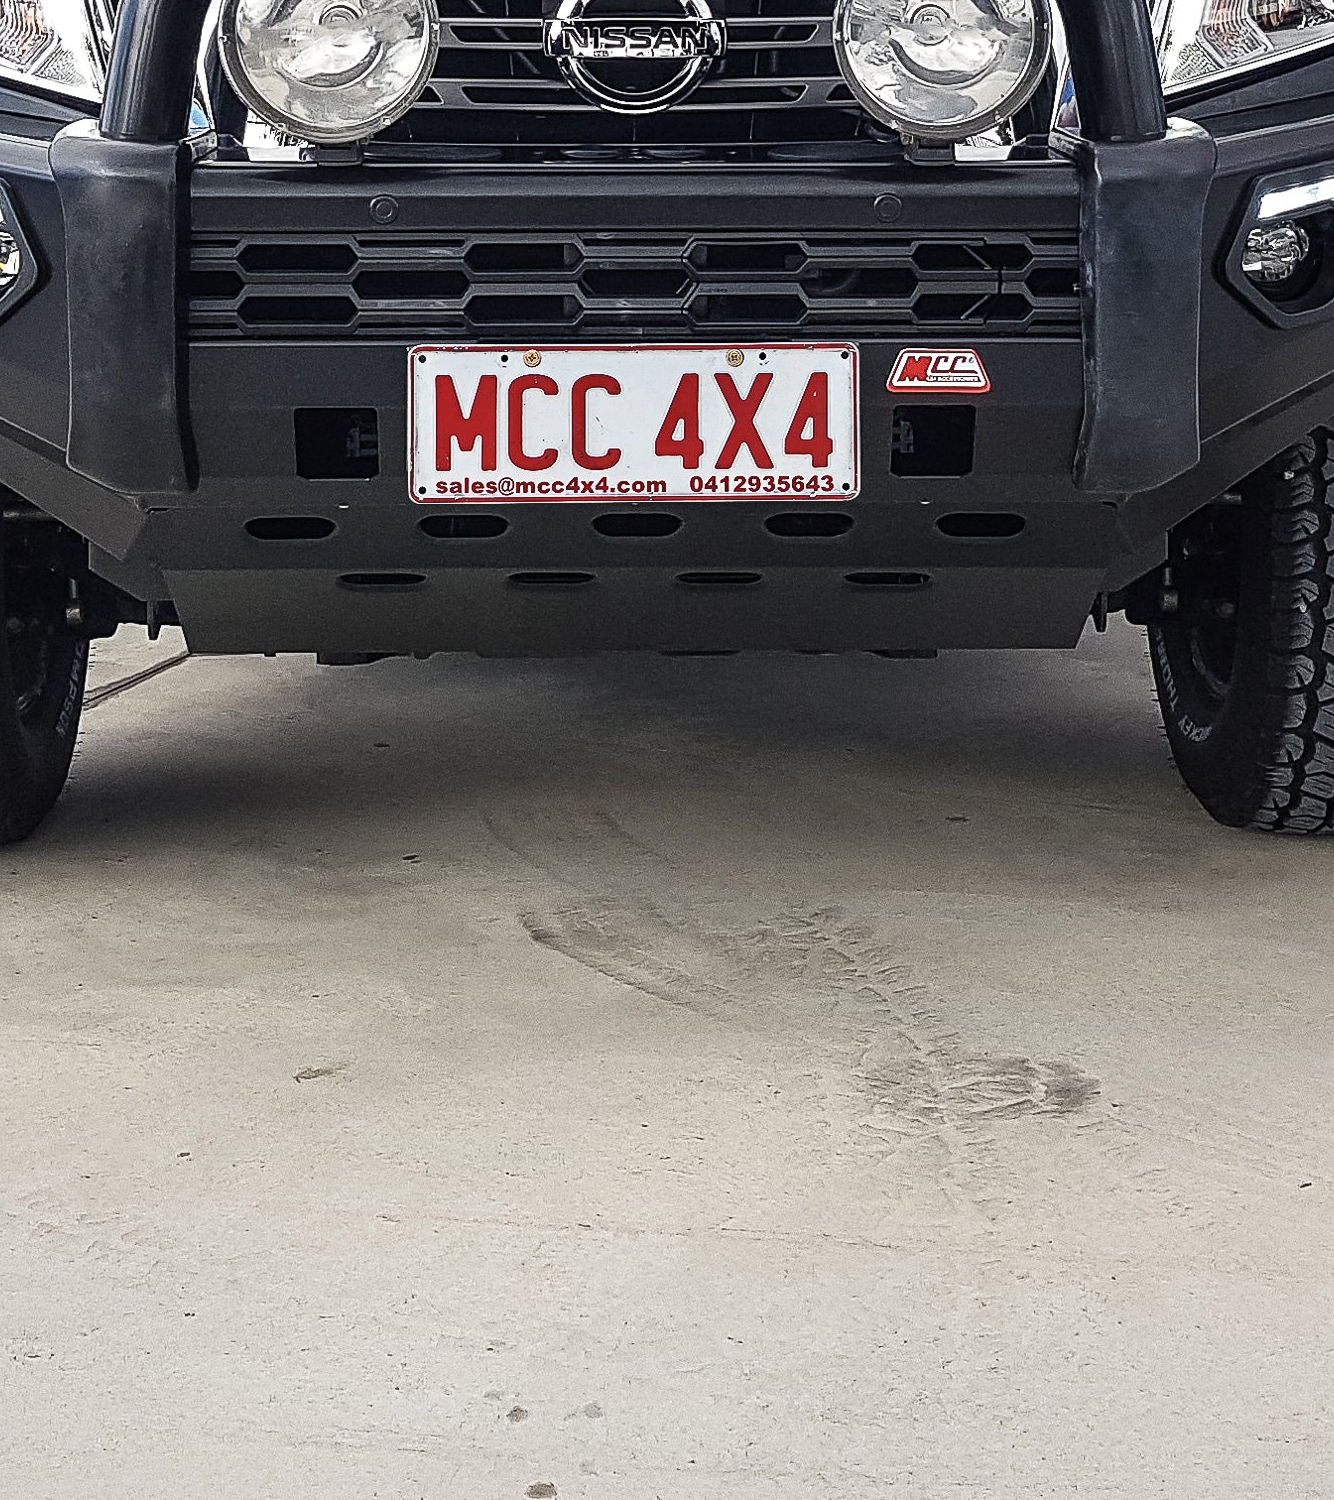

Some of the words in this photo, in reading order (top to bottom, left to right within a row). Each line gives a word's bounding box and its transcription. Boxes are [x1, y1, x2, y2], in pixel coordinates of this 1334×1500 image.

[561, 26, 708, 50] NISSAN
[897, 355, 979, 382] MCC
[434, 373, 622, 471] MCC
[654, 372, 835, 470] 4X4
[435, 476, 667, 495] sales@mcc4x4.com
[689, 475, 835, 494] 0412935643
